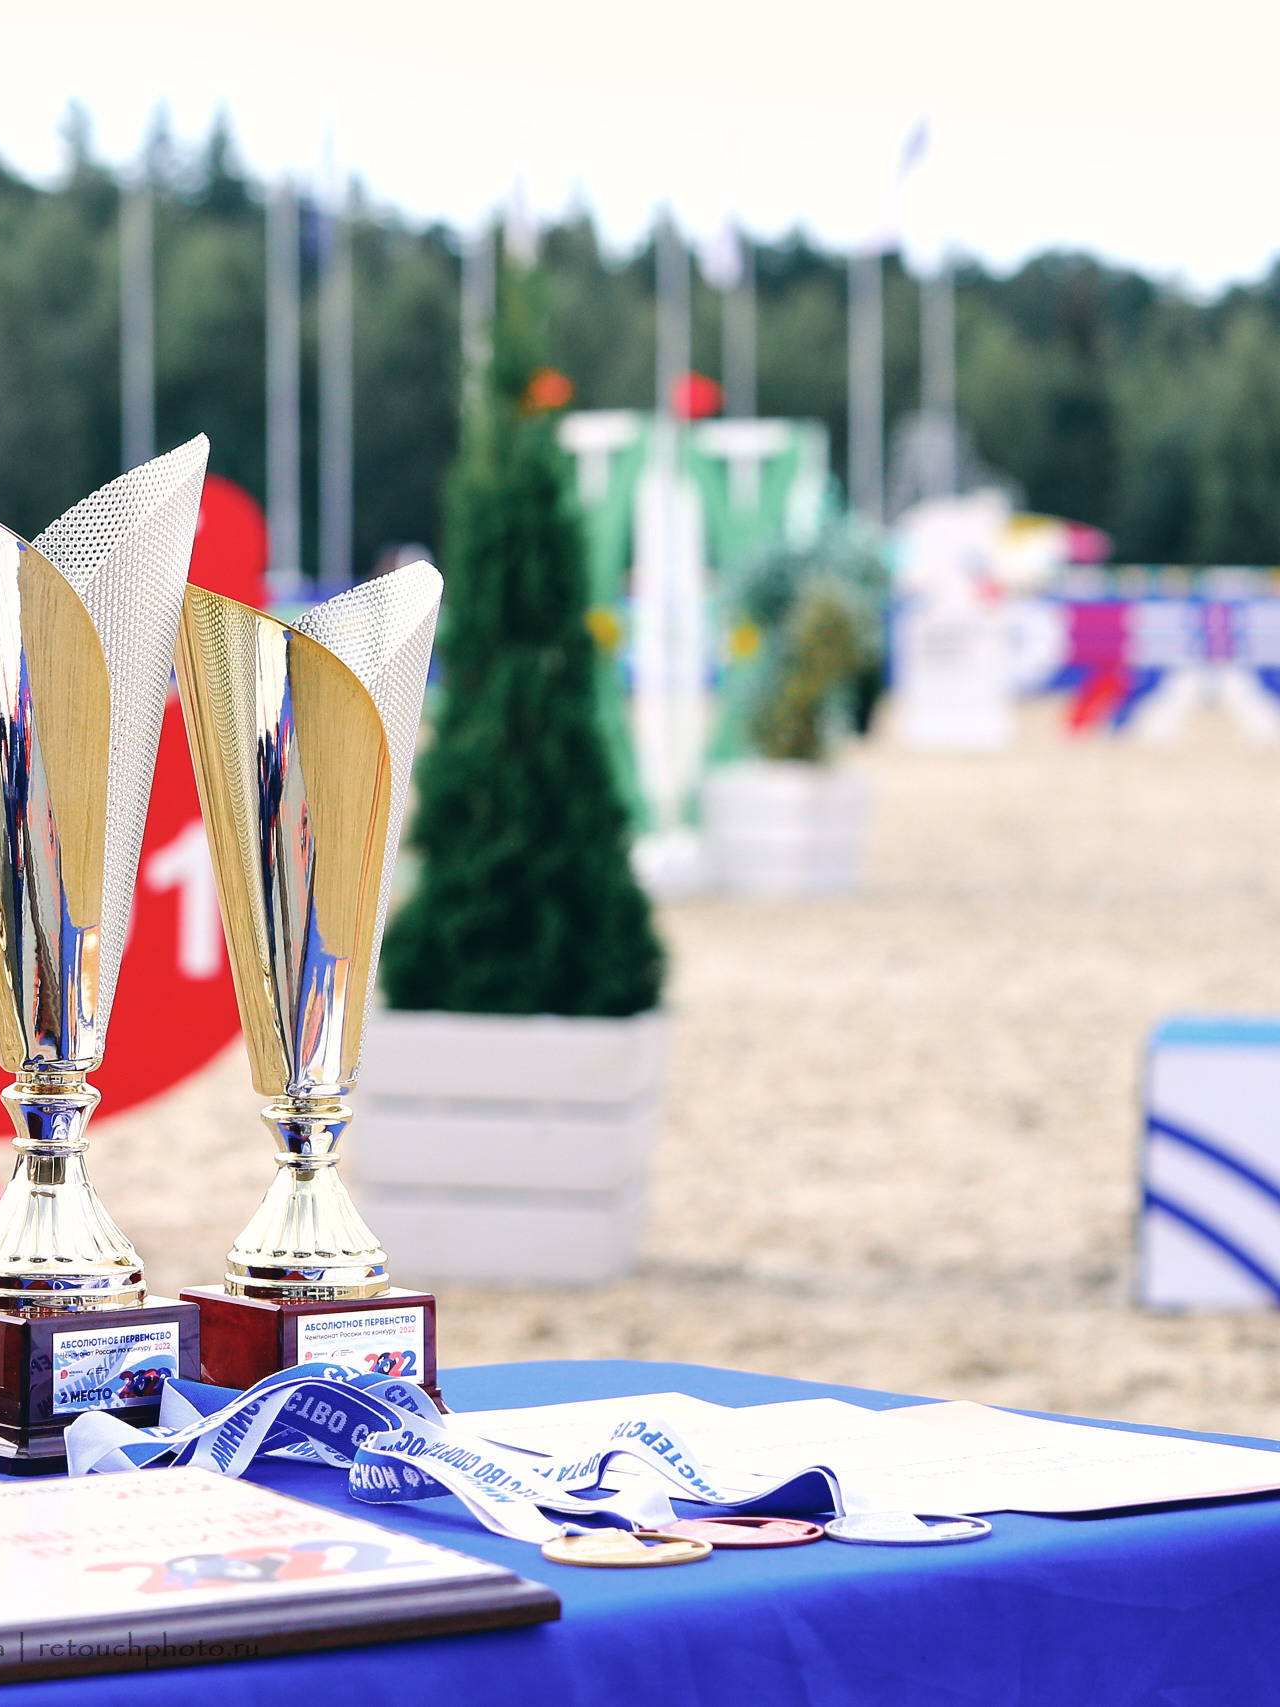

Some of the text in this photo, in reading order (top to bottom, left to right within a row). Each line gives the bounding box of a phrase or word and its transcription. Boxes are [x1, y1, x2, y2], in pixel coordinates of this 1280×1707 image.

[305, 1315, 416, 1331] АБСОЛЮТНОЕ ПЕРВЕНСТВО
[60, 1331, 171, 1349] АБСОЛЮТНОЕ ПЕРВЕНСТВО
[305, 1332, 339, 1341] Чемпионат
[400, 1326, 416, 1334] 2022
[154, 1343, 171, 1351] 2022
[60, 1387, 113, 1404] 2 МЕСТО
